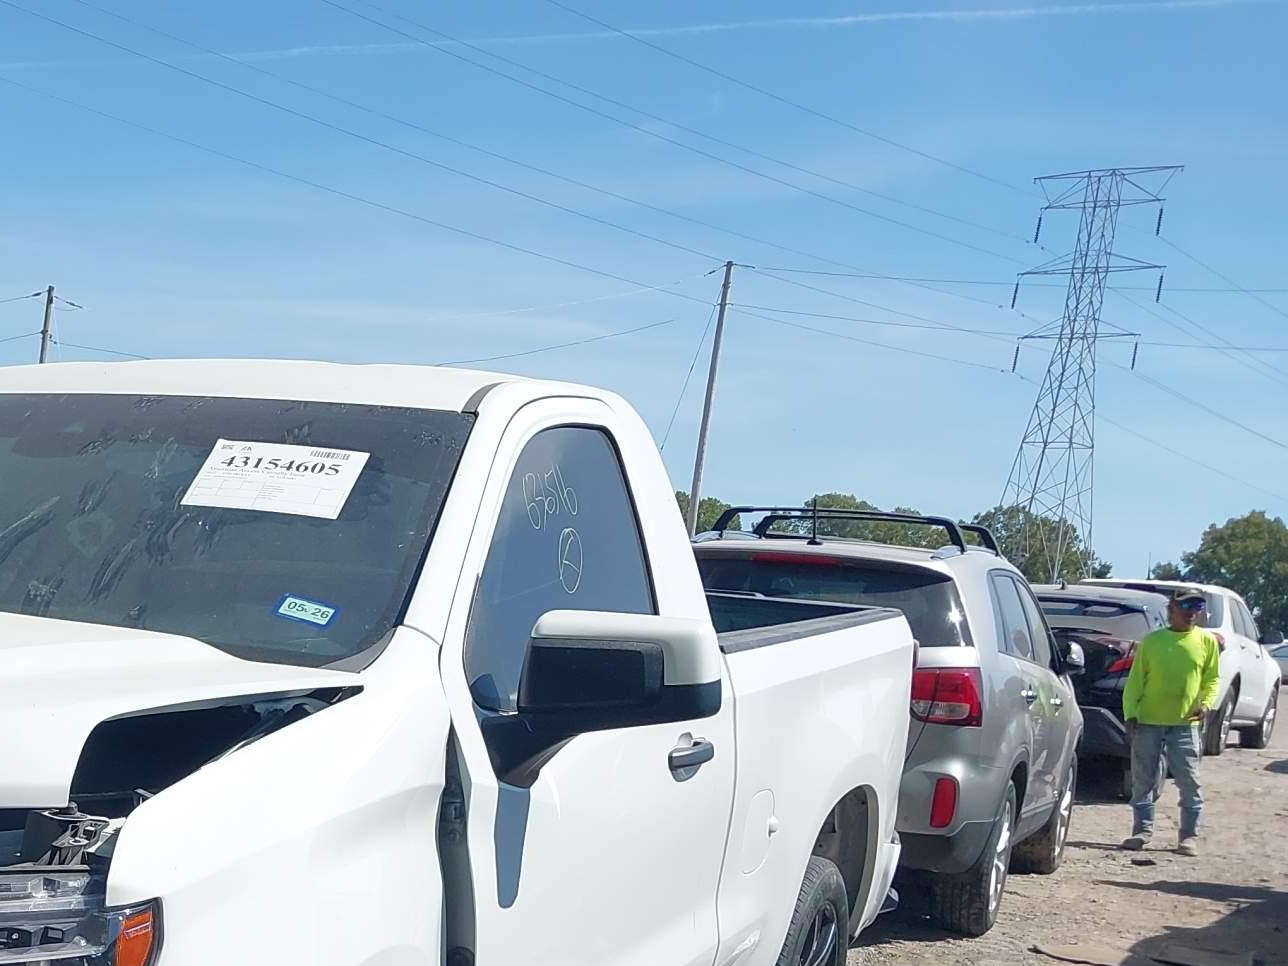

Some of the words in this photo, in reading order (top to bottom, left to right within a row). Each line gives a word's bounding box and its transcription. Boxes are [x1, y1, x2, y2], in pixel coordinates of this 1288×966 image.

[220, 454, 344, 477] 43154605
[287, 601, 306, 613] 05
[311, 607, 330, 619] 26
